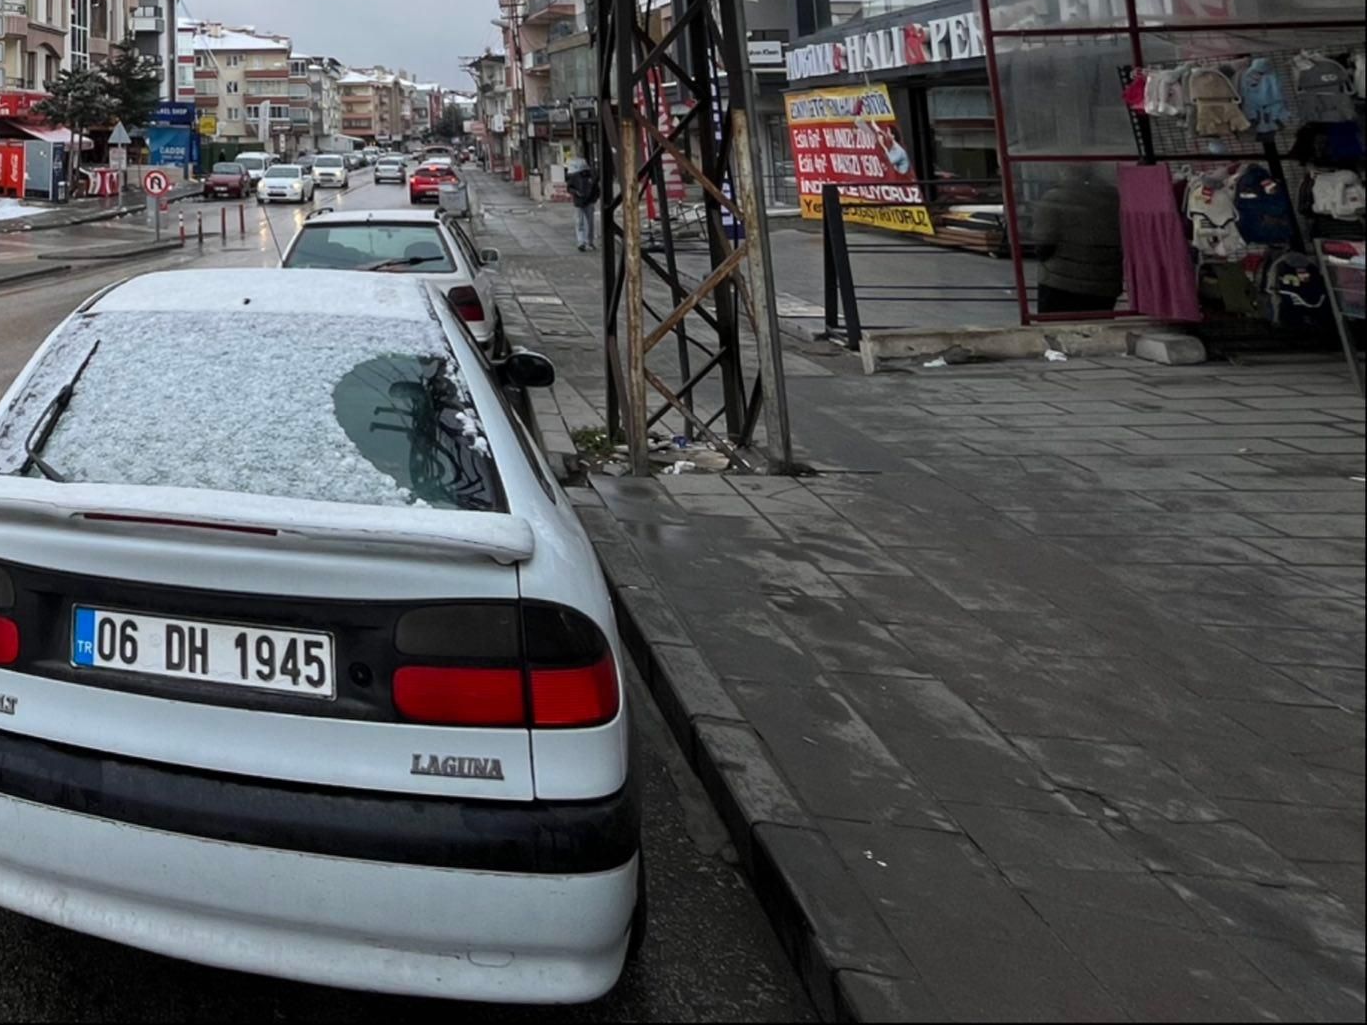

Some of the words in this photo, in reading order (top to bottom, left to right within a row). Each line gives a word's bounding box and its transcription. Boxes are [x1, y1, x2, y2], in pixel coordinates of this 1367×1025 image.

[845, 27, 907, 73] HALI
[77, 640, 92, 655] TR
[97, 617, 138, 665] 06
[165, 623, 209, 675] DH
[235, 632, 326, 689] 1945
[410, 753, 504, 781] LAGUNA
